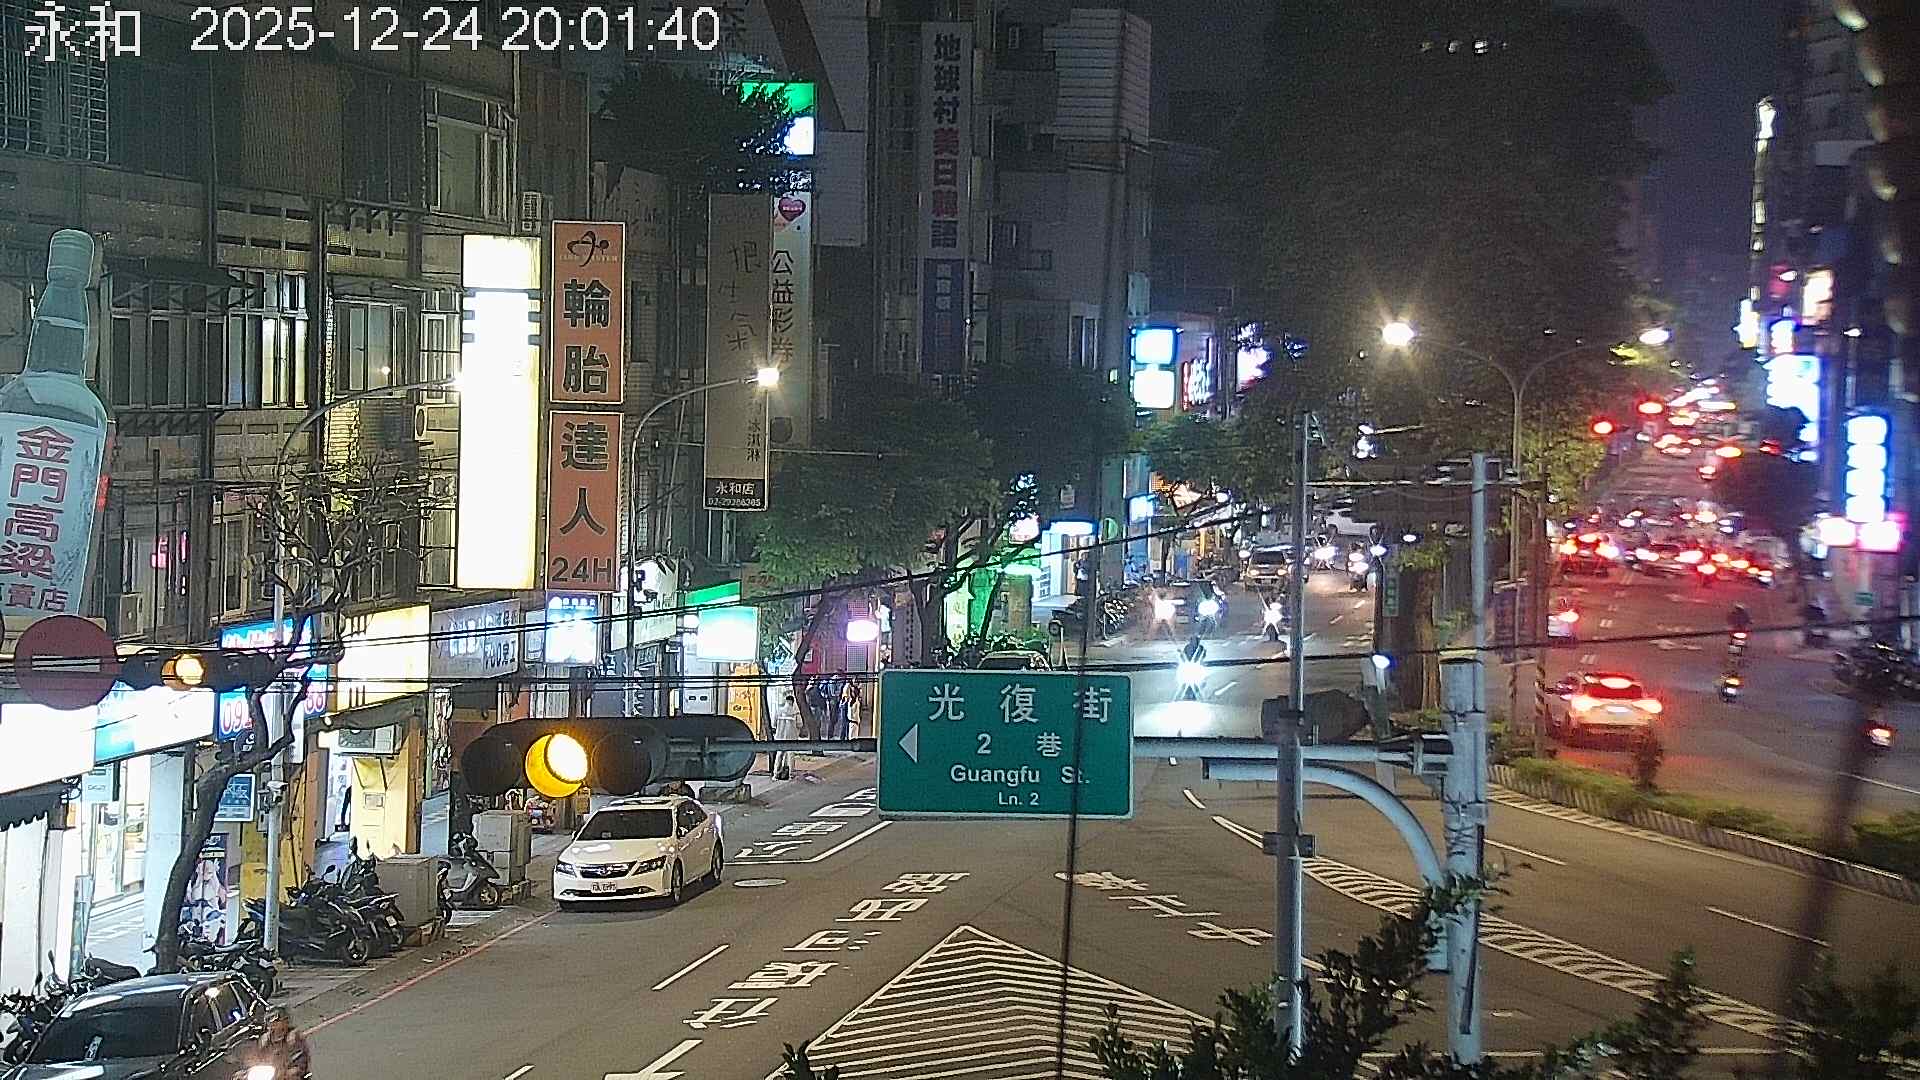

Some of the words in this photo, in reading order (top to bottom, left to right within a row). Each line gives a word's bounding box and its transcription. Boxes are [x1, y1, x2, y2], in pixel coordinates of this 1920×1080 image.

[562, 279, 613, 393] 輪胎
[560, 421, 610, 536] 達人
[715, 481, 755, 496] 永和店
[551, 557, 612, 583] 24H
[928, 683, 1113, 723] 光復街
[950, 765, 1041, 787] Guangfu
[998, 792, 1023, 806] Ln.
[1030, 792, 1040, 806] 2
